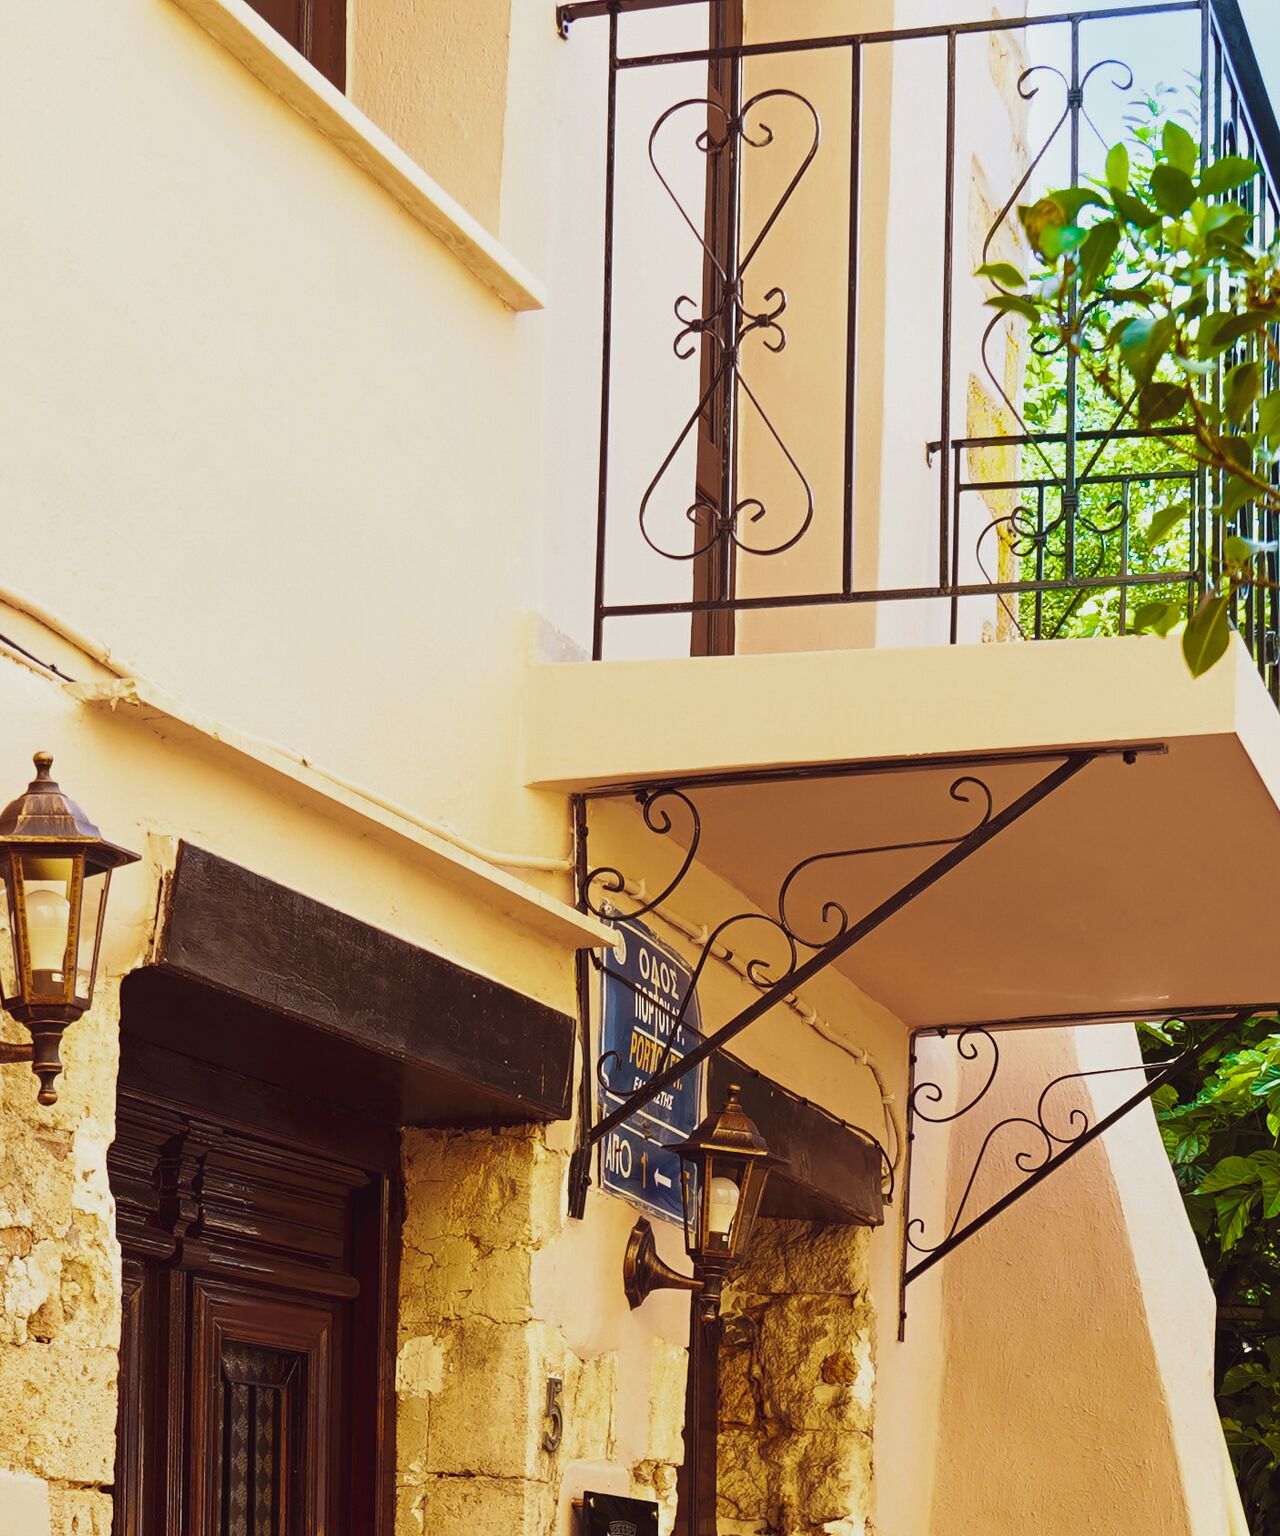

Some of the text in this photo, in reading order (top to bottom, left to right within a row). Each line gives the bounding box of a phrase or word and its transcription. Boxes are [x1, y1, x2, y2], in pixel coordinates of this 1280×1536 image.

[639, 947, 679, 1000] ΟΔΟΣ
[605, 1132, 632, 1178] ΑΠΟ
[542, 1377, 563, 1453] 5
